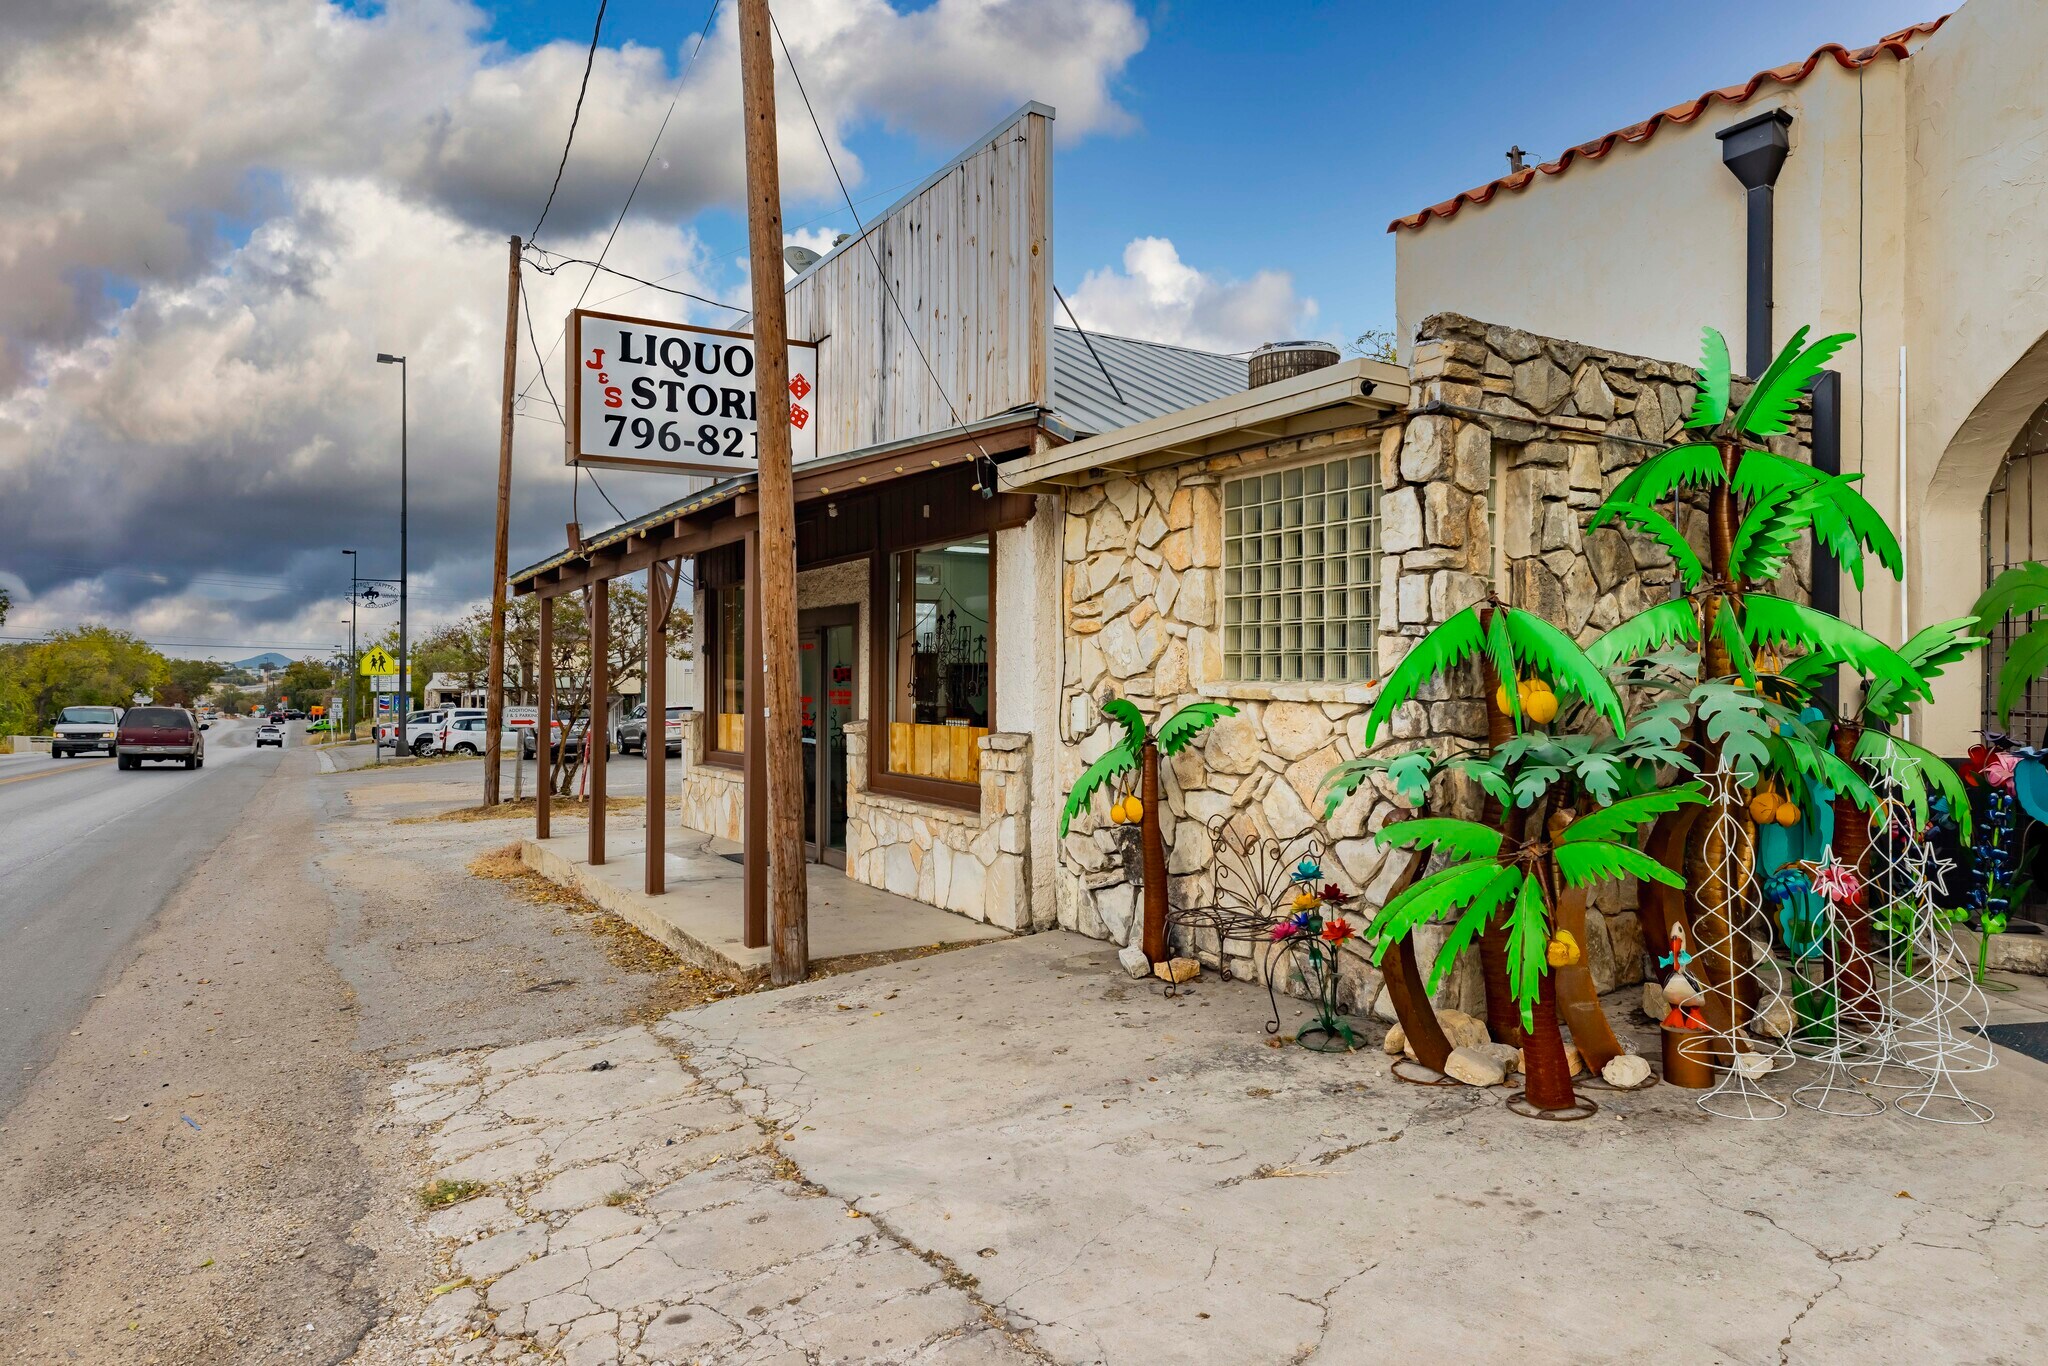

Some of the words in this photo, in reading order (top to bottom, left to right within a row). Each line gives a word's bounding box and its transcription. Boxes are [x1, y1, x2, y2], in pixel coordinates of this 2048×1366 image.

[618, 330, 754, 377] LIQUO
[585, 348, 606, 370] J
[604, 386, 623, 408] S
[604, 414, 758, 459] 796-82
